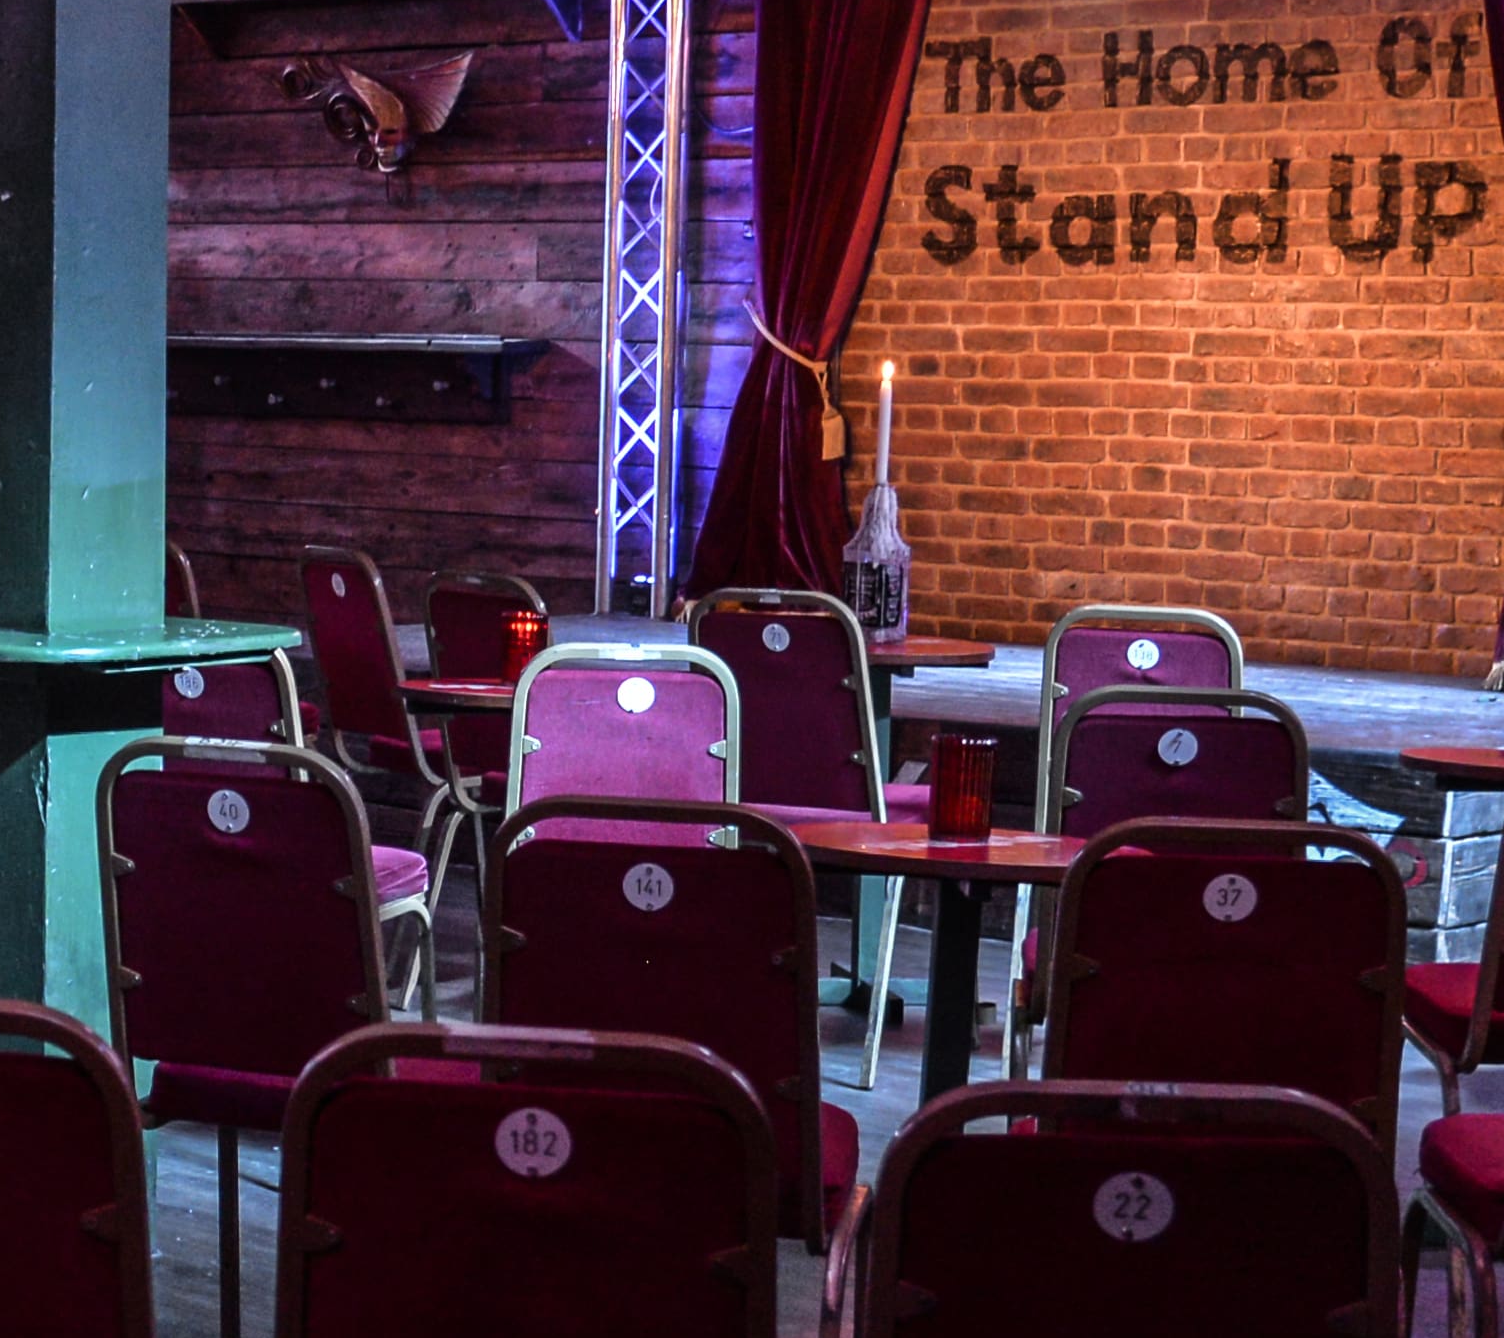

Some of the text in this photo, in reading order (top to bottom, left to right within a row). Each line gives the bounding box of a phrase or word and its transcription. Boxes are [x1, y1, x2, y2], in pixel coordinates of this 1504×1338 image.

[925, 11, 1483, 113] The Home Of
[921, 158, 1289, 265] Stand
[219, 803, 239, 820] 40
[635, 878, 662, 897] 141
[1216, 888, 1243, 907] 37
[509, 1129, 557, 1157] 182
[1114, 1192, 1152, 1221] 22
